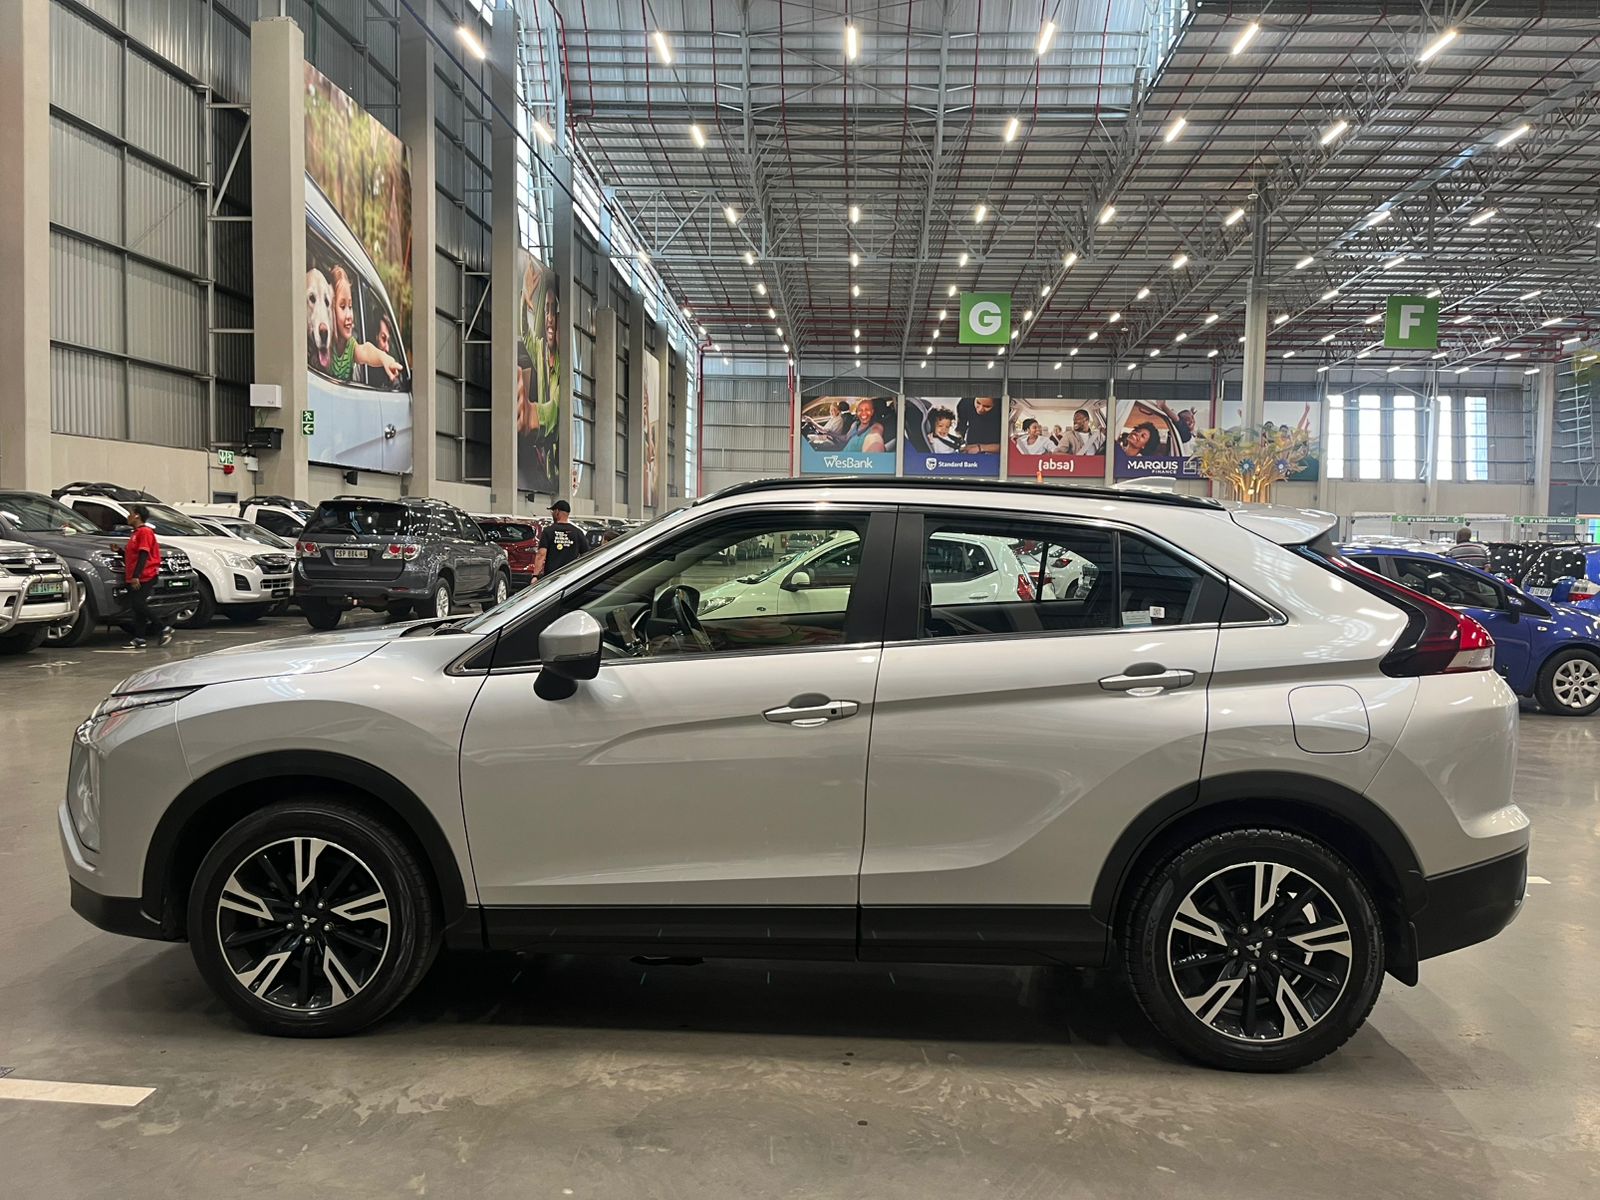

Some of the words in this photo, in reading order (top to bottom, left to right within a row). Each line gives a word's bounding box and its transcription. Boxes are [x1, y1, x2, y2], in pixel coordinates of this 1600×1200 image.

[968, 301, 1002, 336] G
[1398, 304, 1425, 339] F
[823, 455, 873, 468] WesBank
[1127, 460, 1178, 470] MARQUIS
